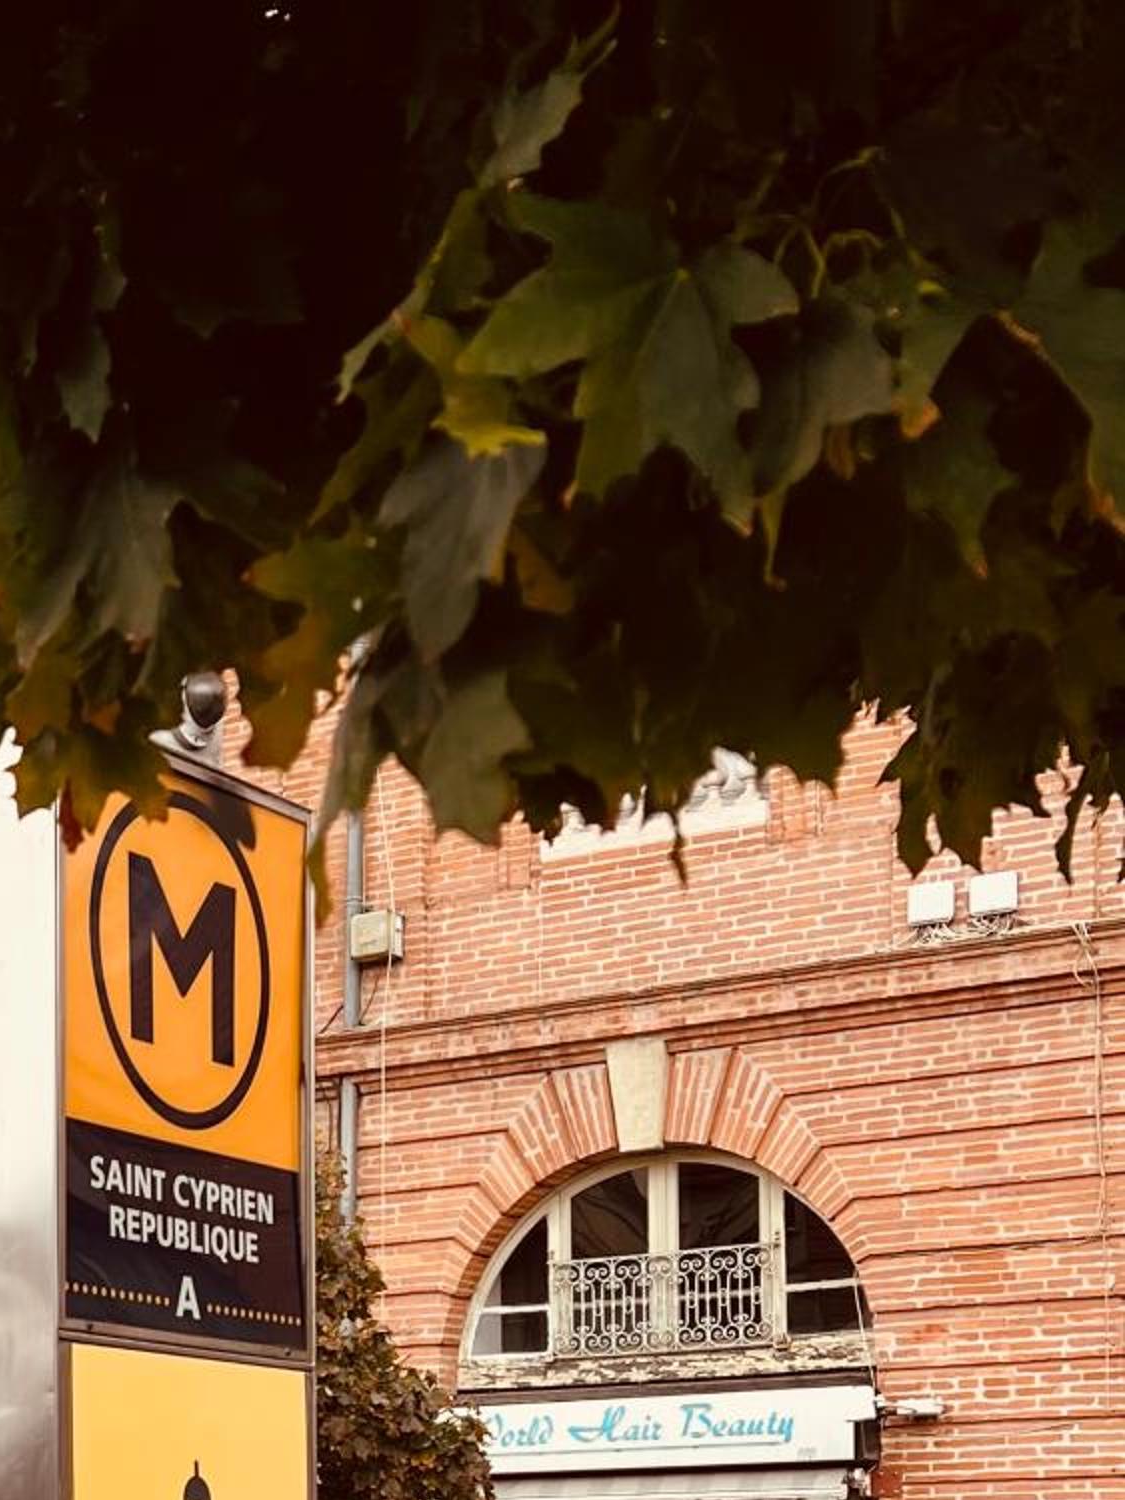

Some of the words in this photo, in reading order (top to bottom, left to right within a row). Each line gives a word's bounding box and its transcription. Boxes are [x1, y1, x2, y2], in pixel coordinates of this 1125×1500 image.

[128, 851, 236, 1068] M
[90, 1155, 166, 1202] SAINT
[173, 1174, 274, 1225] CYPRIEN
[109, 1204, 260, 1264] REPUBLIQUE
[176, 1275, 201, 1320] A
[567, 1404, 662, 1442] Hair
[680, 1402, 794, 1442] Beauty
